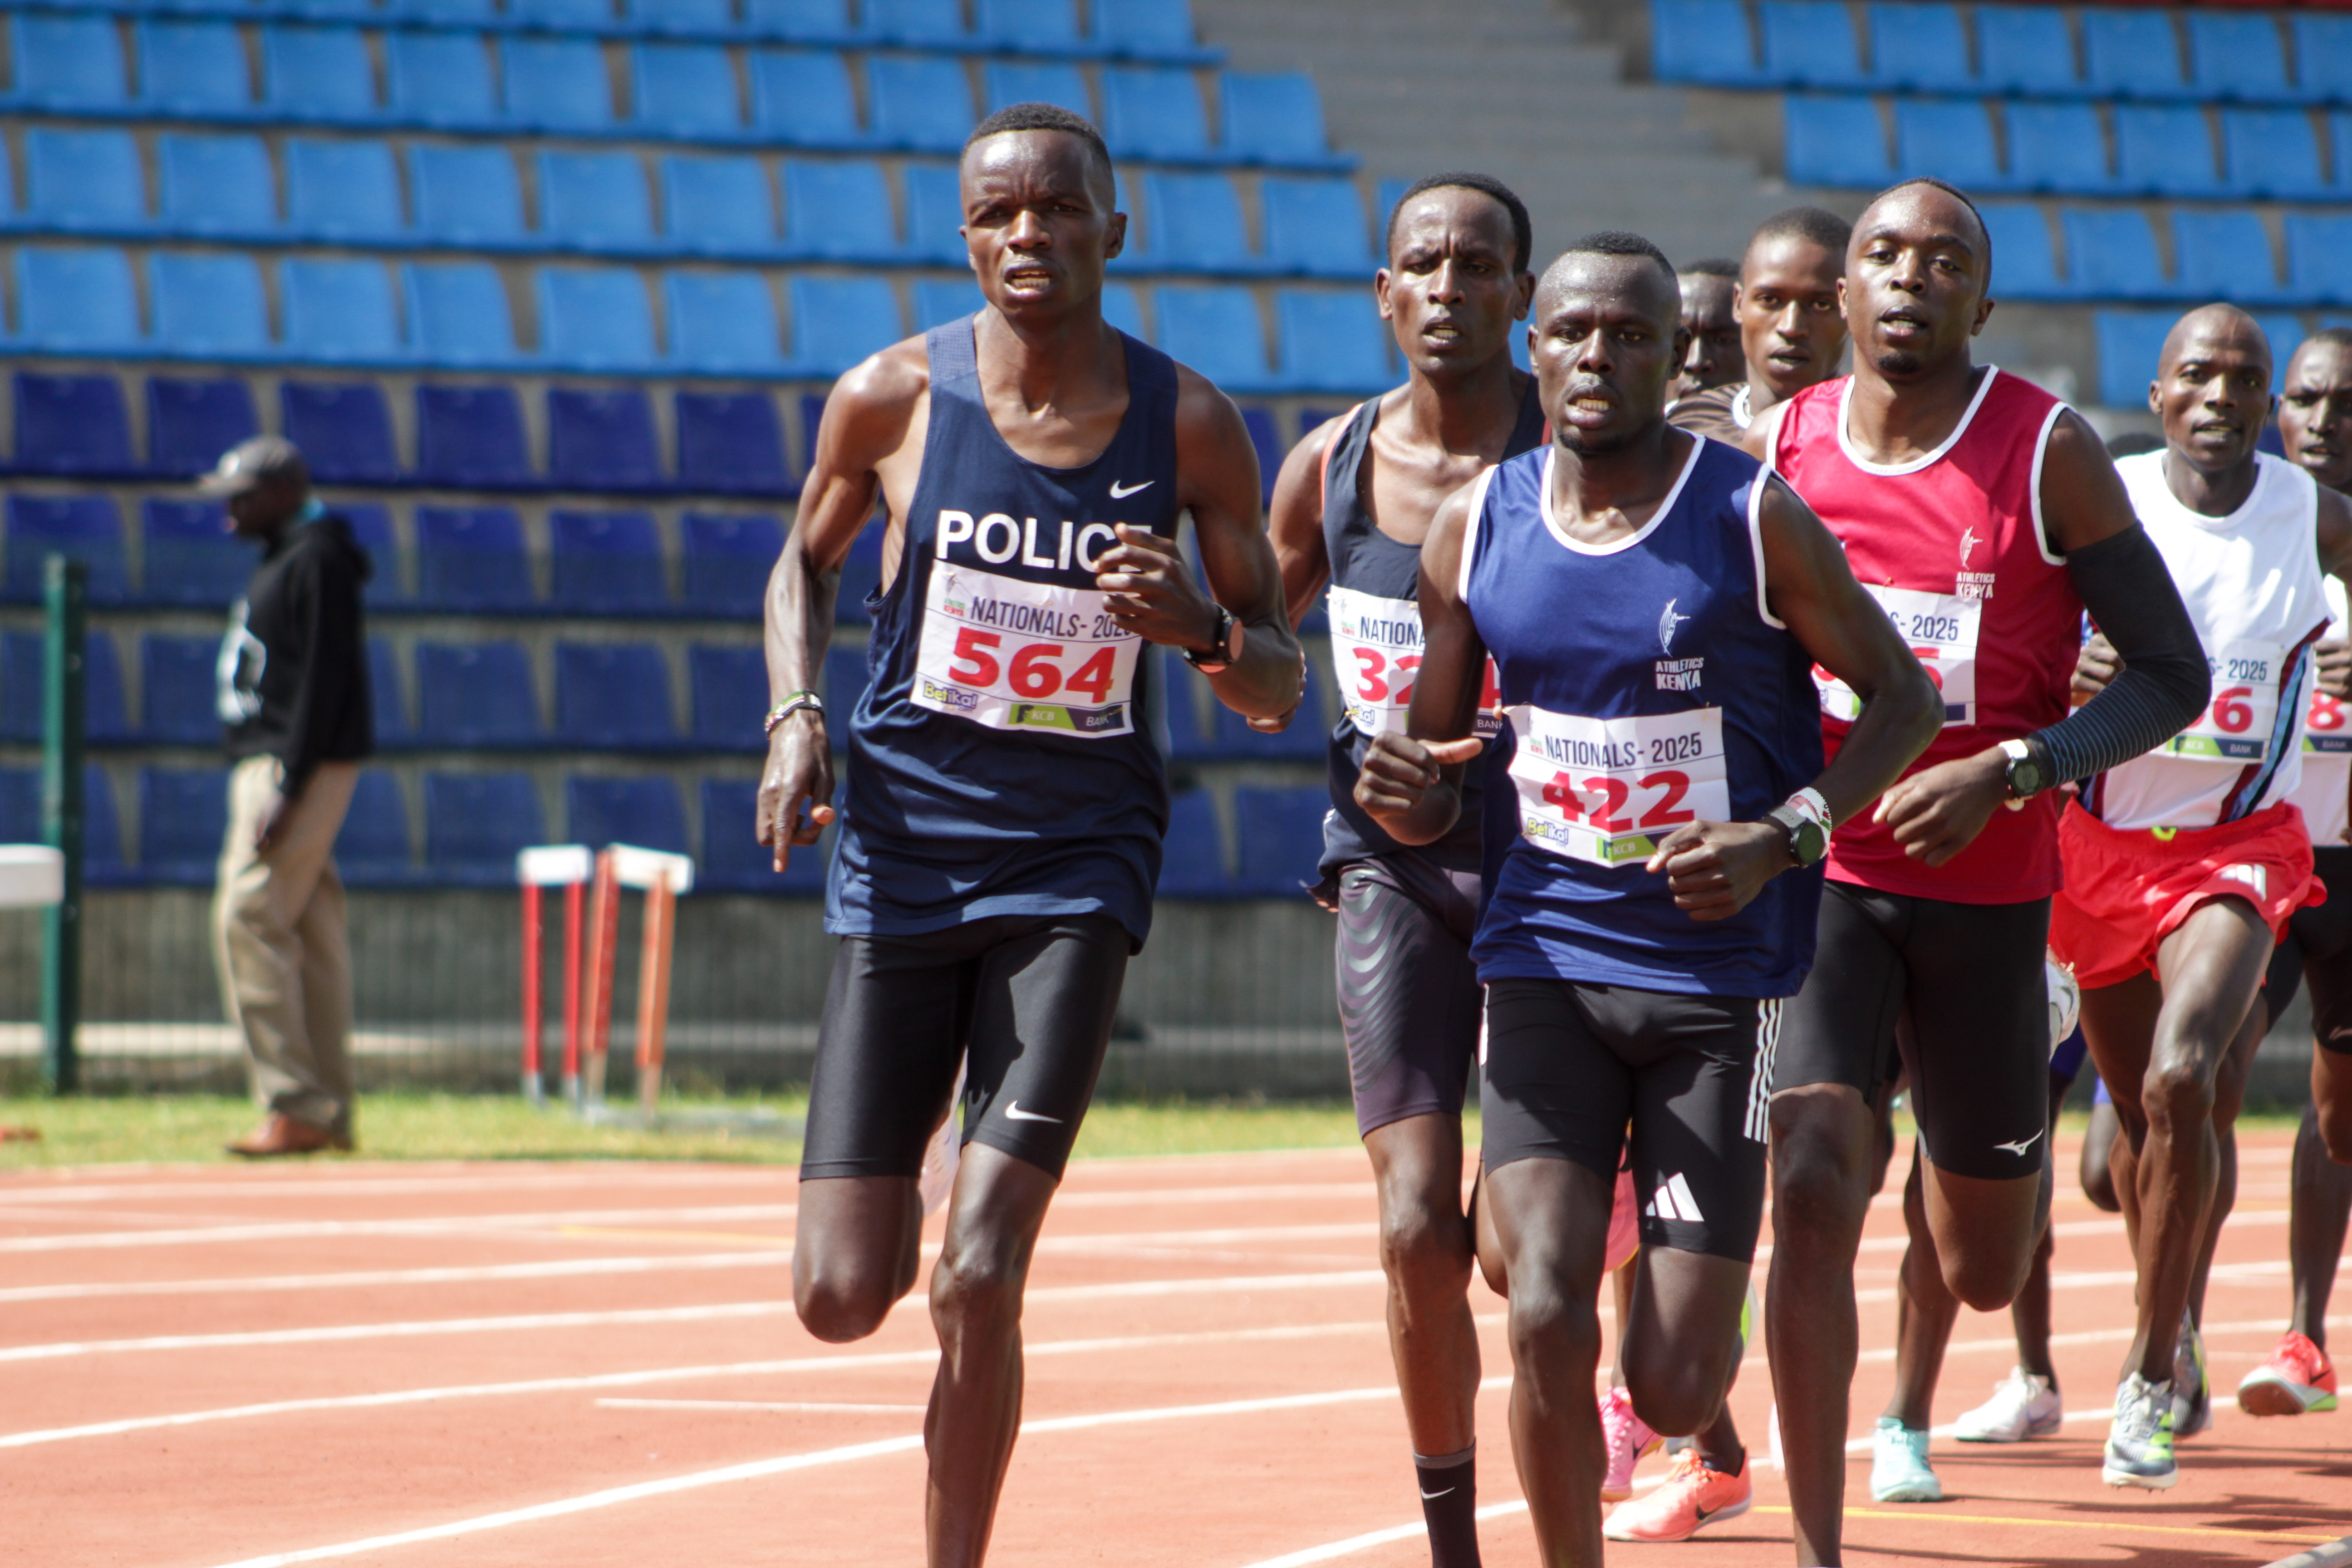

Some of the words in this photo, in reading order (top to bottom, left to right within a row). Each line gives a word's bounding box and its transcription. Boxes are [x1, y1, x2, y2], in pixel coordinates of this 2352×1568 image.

[1956, 571, 1995, 584] ATHLETICS
[1955, 583, 1994, 599] KENYA
[970, 595, 1087, 637] NATIONALS-
[1911, 614, 1959, 642] 2025
[948, 626, 1117, 704] 564
[1655, 657, 1704, 673] ATHLETICS
[2228, 659, 2268, 681] 2025
[1656, 669, 1701, 691] KENYA
[923, 680, 978, 710] Betika!
[1031, 709, 1056, 722] KCB
[1085, 715, 1110, 727] BANK
[1546, 734, 1645, 769] NATIONALS-
[1651, 731, 1703, 763] 2025
[2229, 743, 2252, 755] BANK
[1542, 770, 1695, 833] 422
[1527, 817, 1569, 846] Betika!
[1612, 841, 1636, 855] KCB
